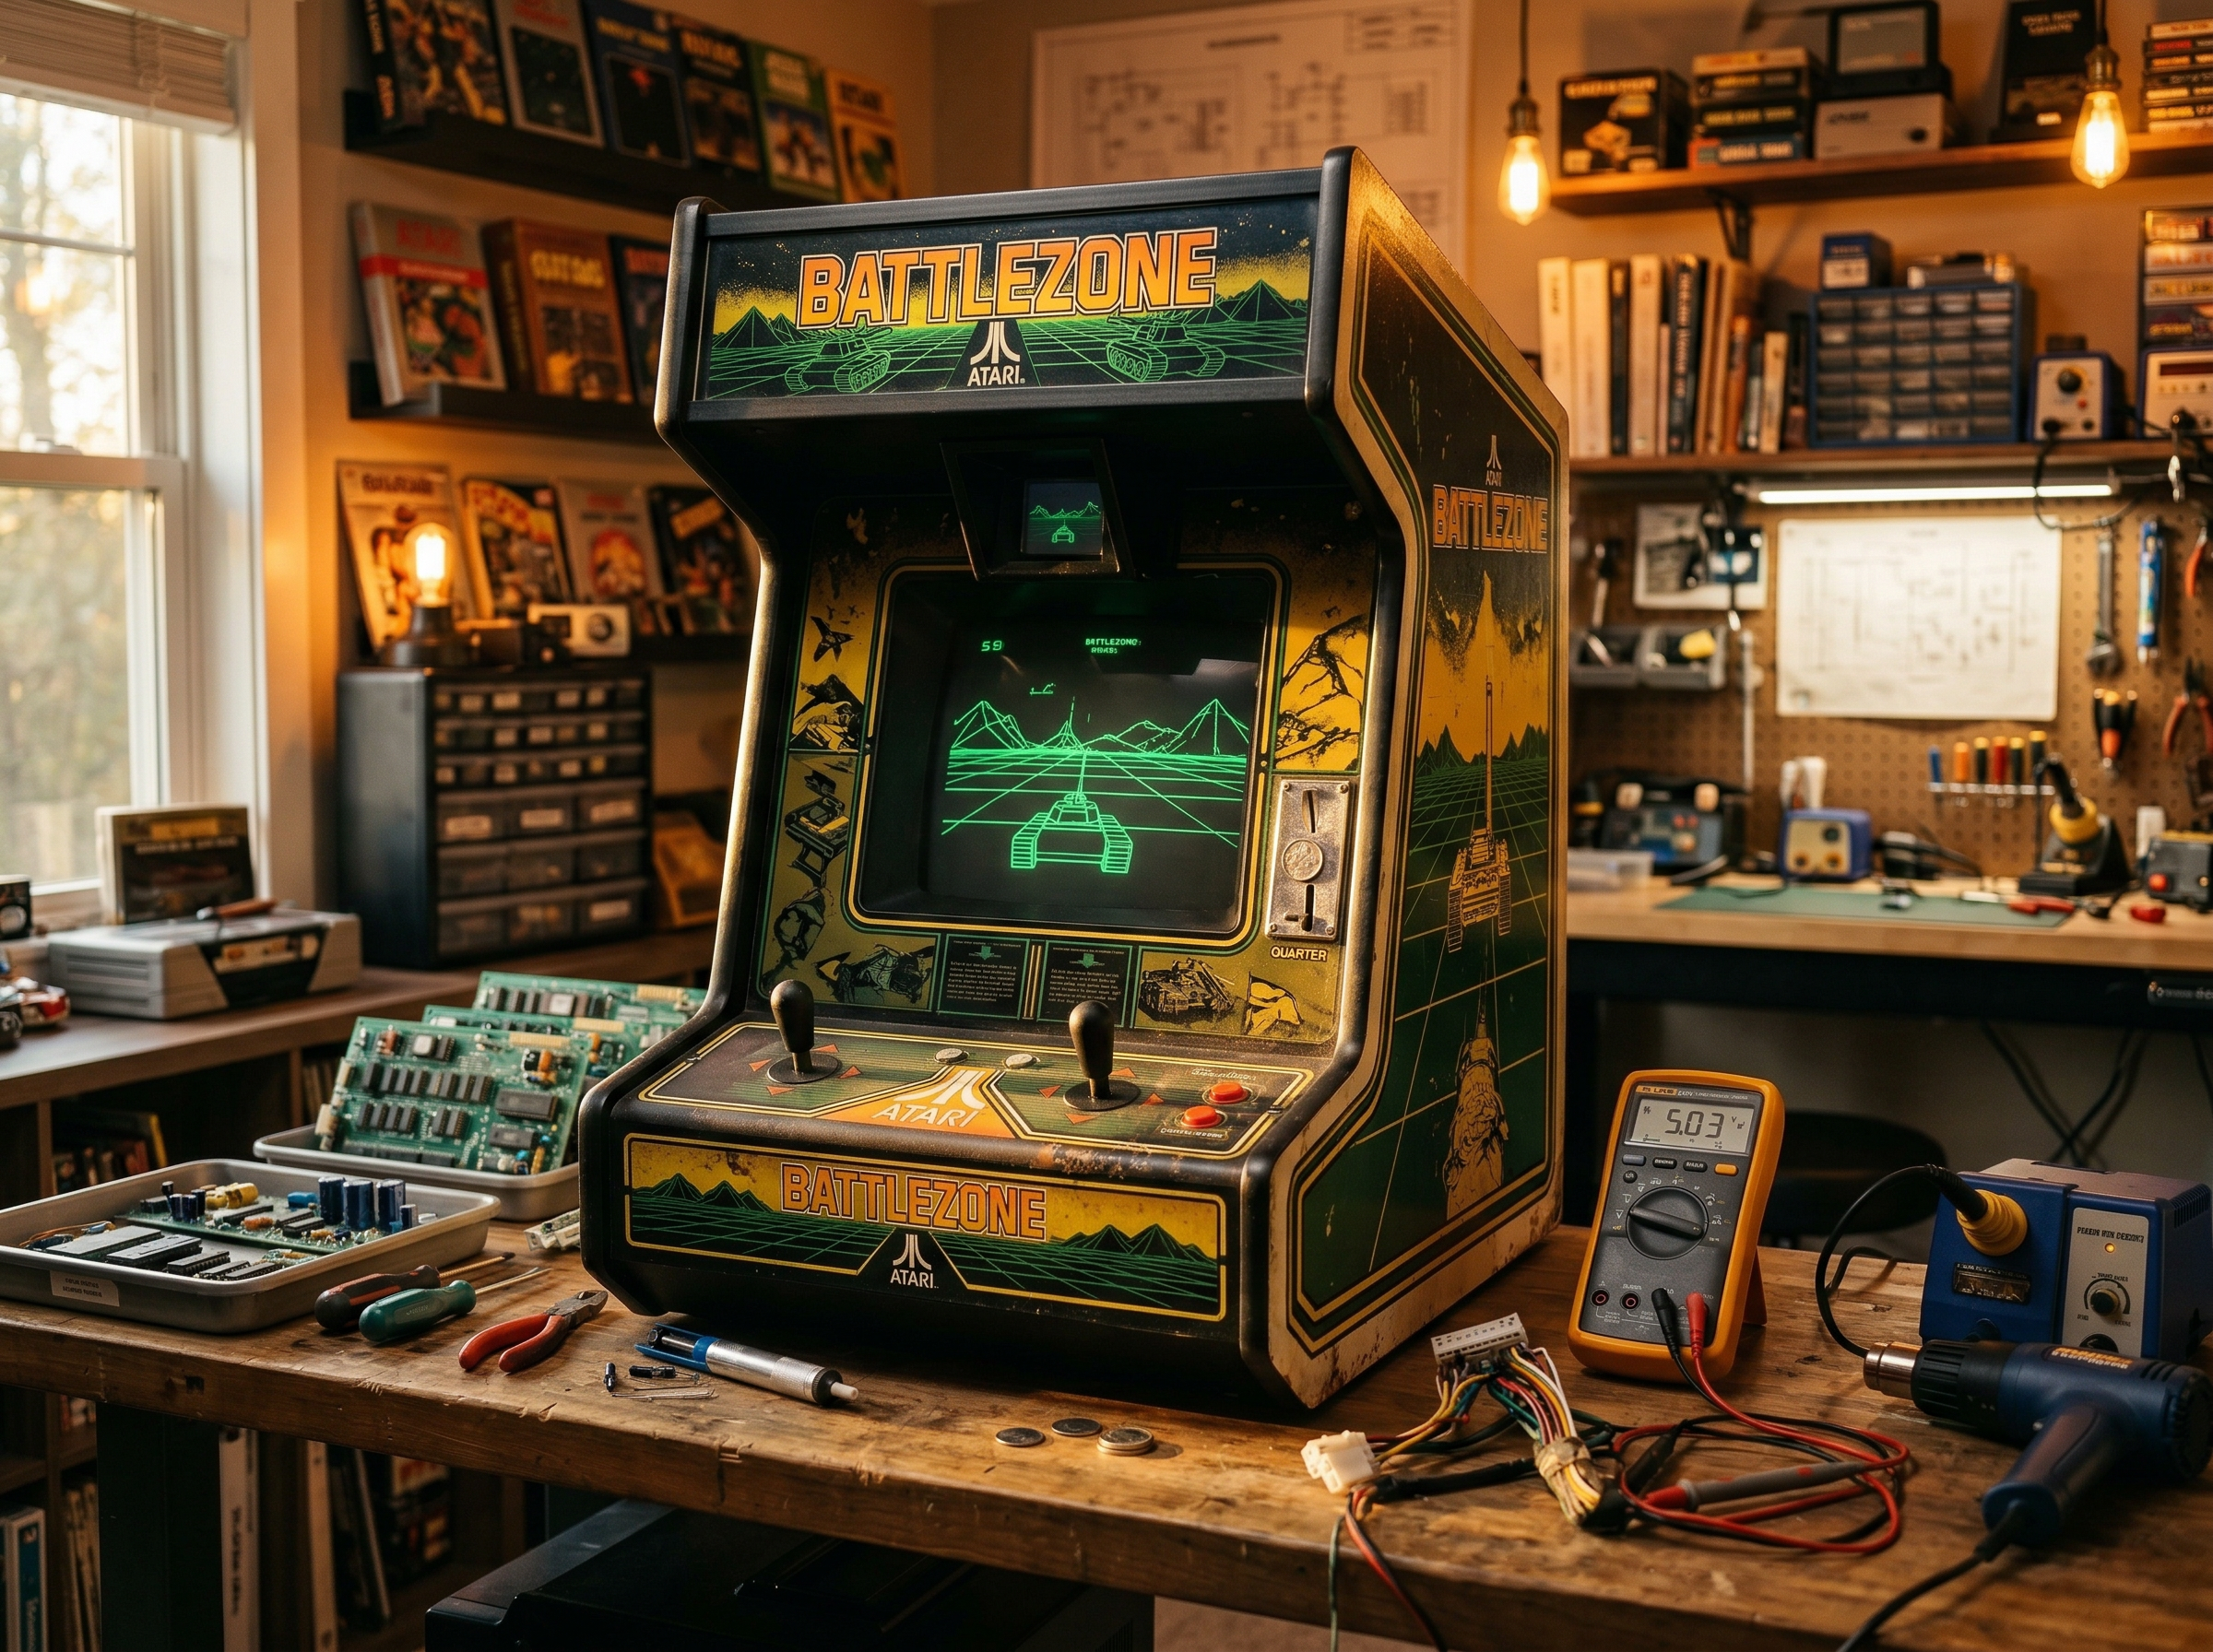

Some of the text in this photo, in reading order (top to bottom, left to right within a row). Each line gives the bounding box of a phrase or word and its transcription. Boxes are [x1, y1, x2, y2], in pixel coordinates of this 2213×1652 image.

[796, 227, 1217, 330] BATTLEZONE
[967, 365, 1021, 387] ATARI
[1433, 484, 1548, 553] BATTLEZONE
[1271, 946, 1327, 962] QUARTER
[871, 1103, 980, 1128] ATARI
[1664, 1109, 1724, 1139] 5.03
[781, 1162, 1047, 1242] BATTLEZONE
[890, 1268, 935, 1289] ATARI
